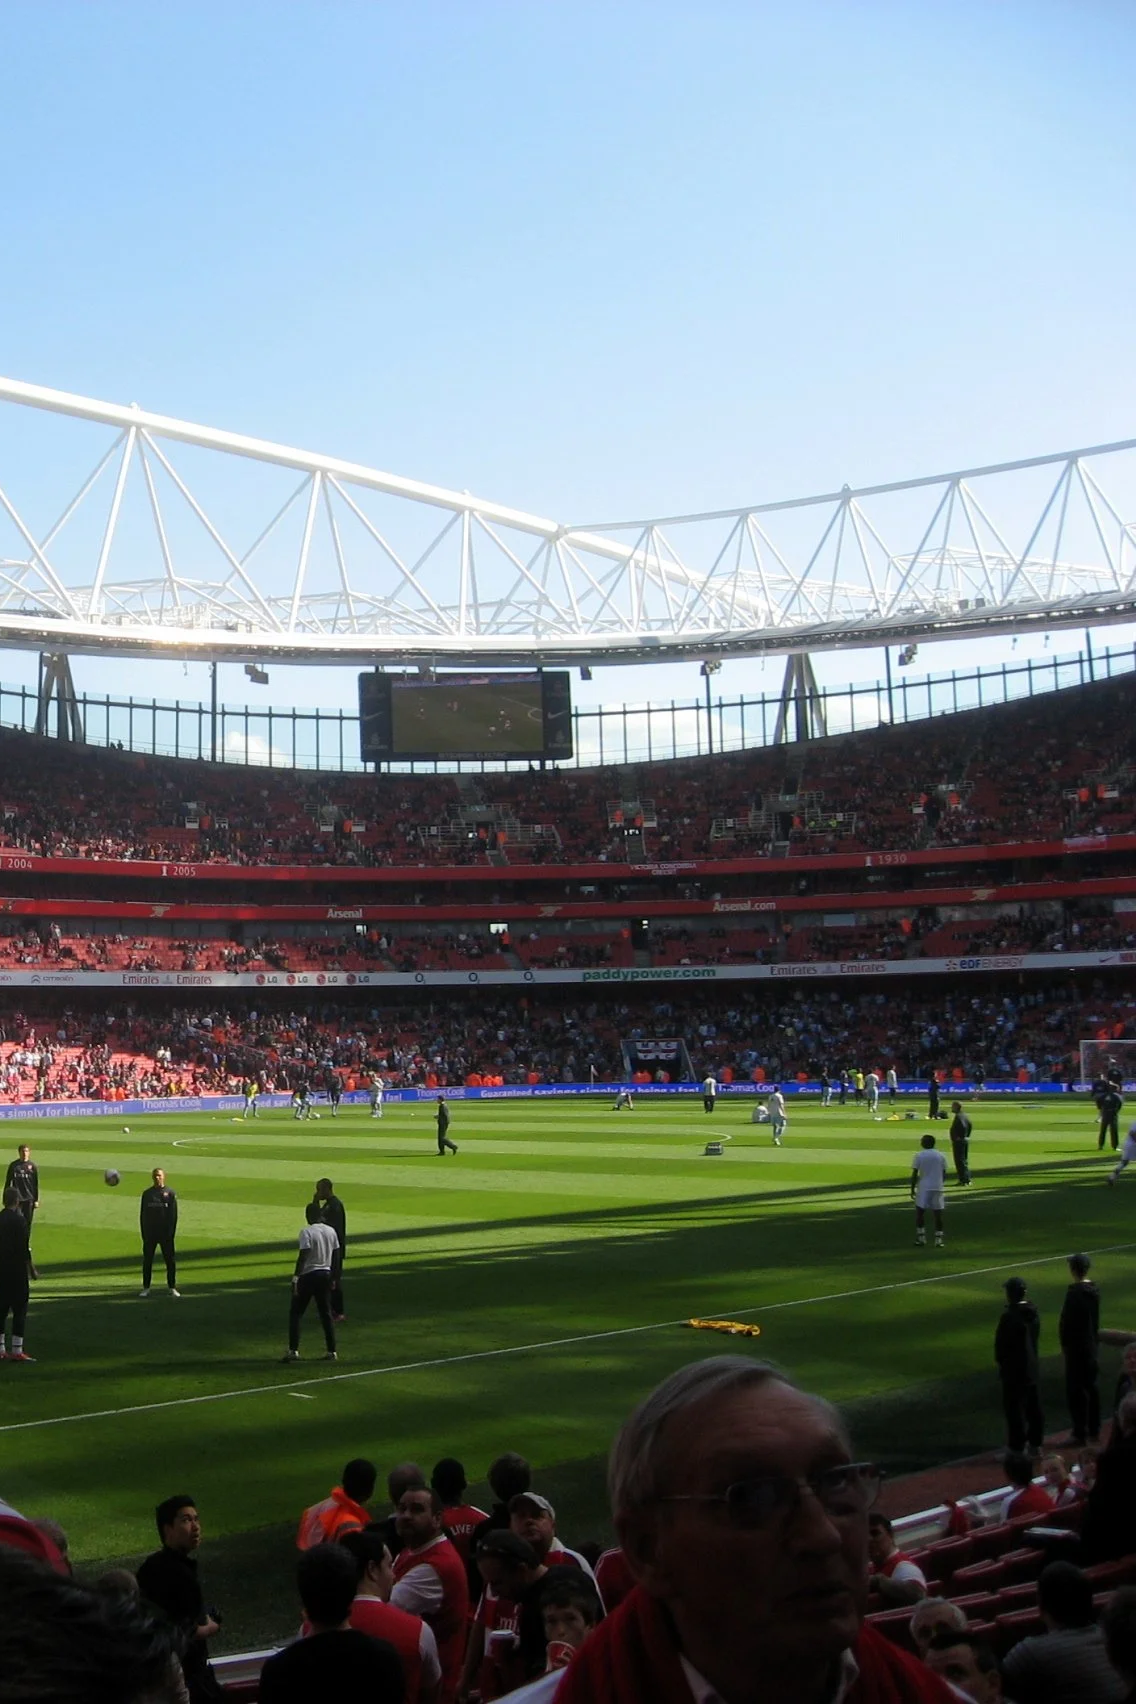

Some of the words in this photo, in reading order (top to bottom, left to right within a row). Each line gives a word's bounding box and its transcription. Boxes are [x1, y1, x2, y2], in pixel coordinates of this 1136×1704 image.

[8, 858, 33, 869] 2004
[878, 853, 907, 865] 1930
[173, 866, 196, 877] 2005
[713, 900, 776, 912] Arsenal.com
[327, 908, 363, 919] Arsenal
[582, 967, 716, 982] paddypower.com
[771, 964, 817, 976] Emirates
[840, 962, 886, 974] Emirates
[122, 973, 159, 985] Emirates
[176, 973, 212, 985] Emirates
[267, 976, 278, 984] LG
[298, 976, 308, 984] LG
[328, 976, 338, 984] LG
[718, 1083, 755, 1092] Tomas
[7, 1106, 44, 1118] simply
[46, 1105, 61, 1116] for
[63, 1105, 93, 1116] being
[103, 1104, 123, 1114] fan!
